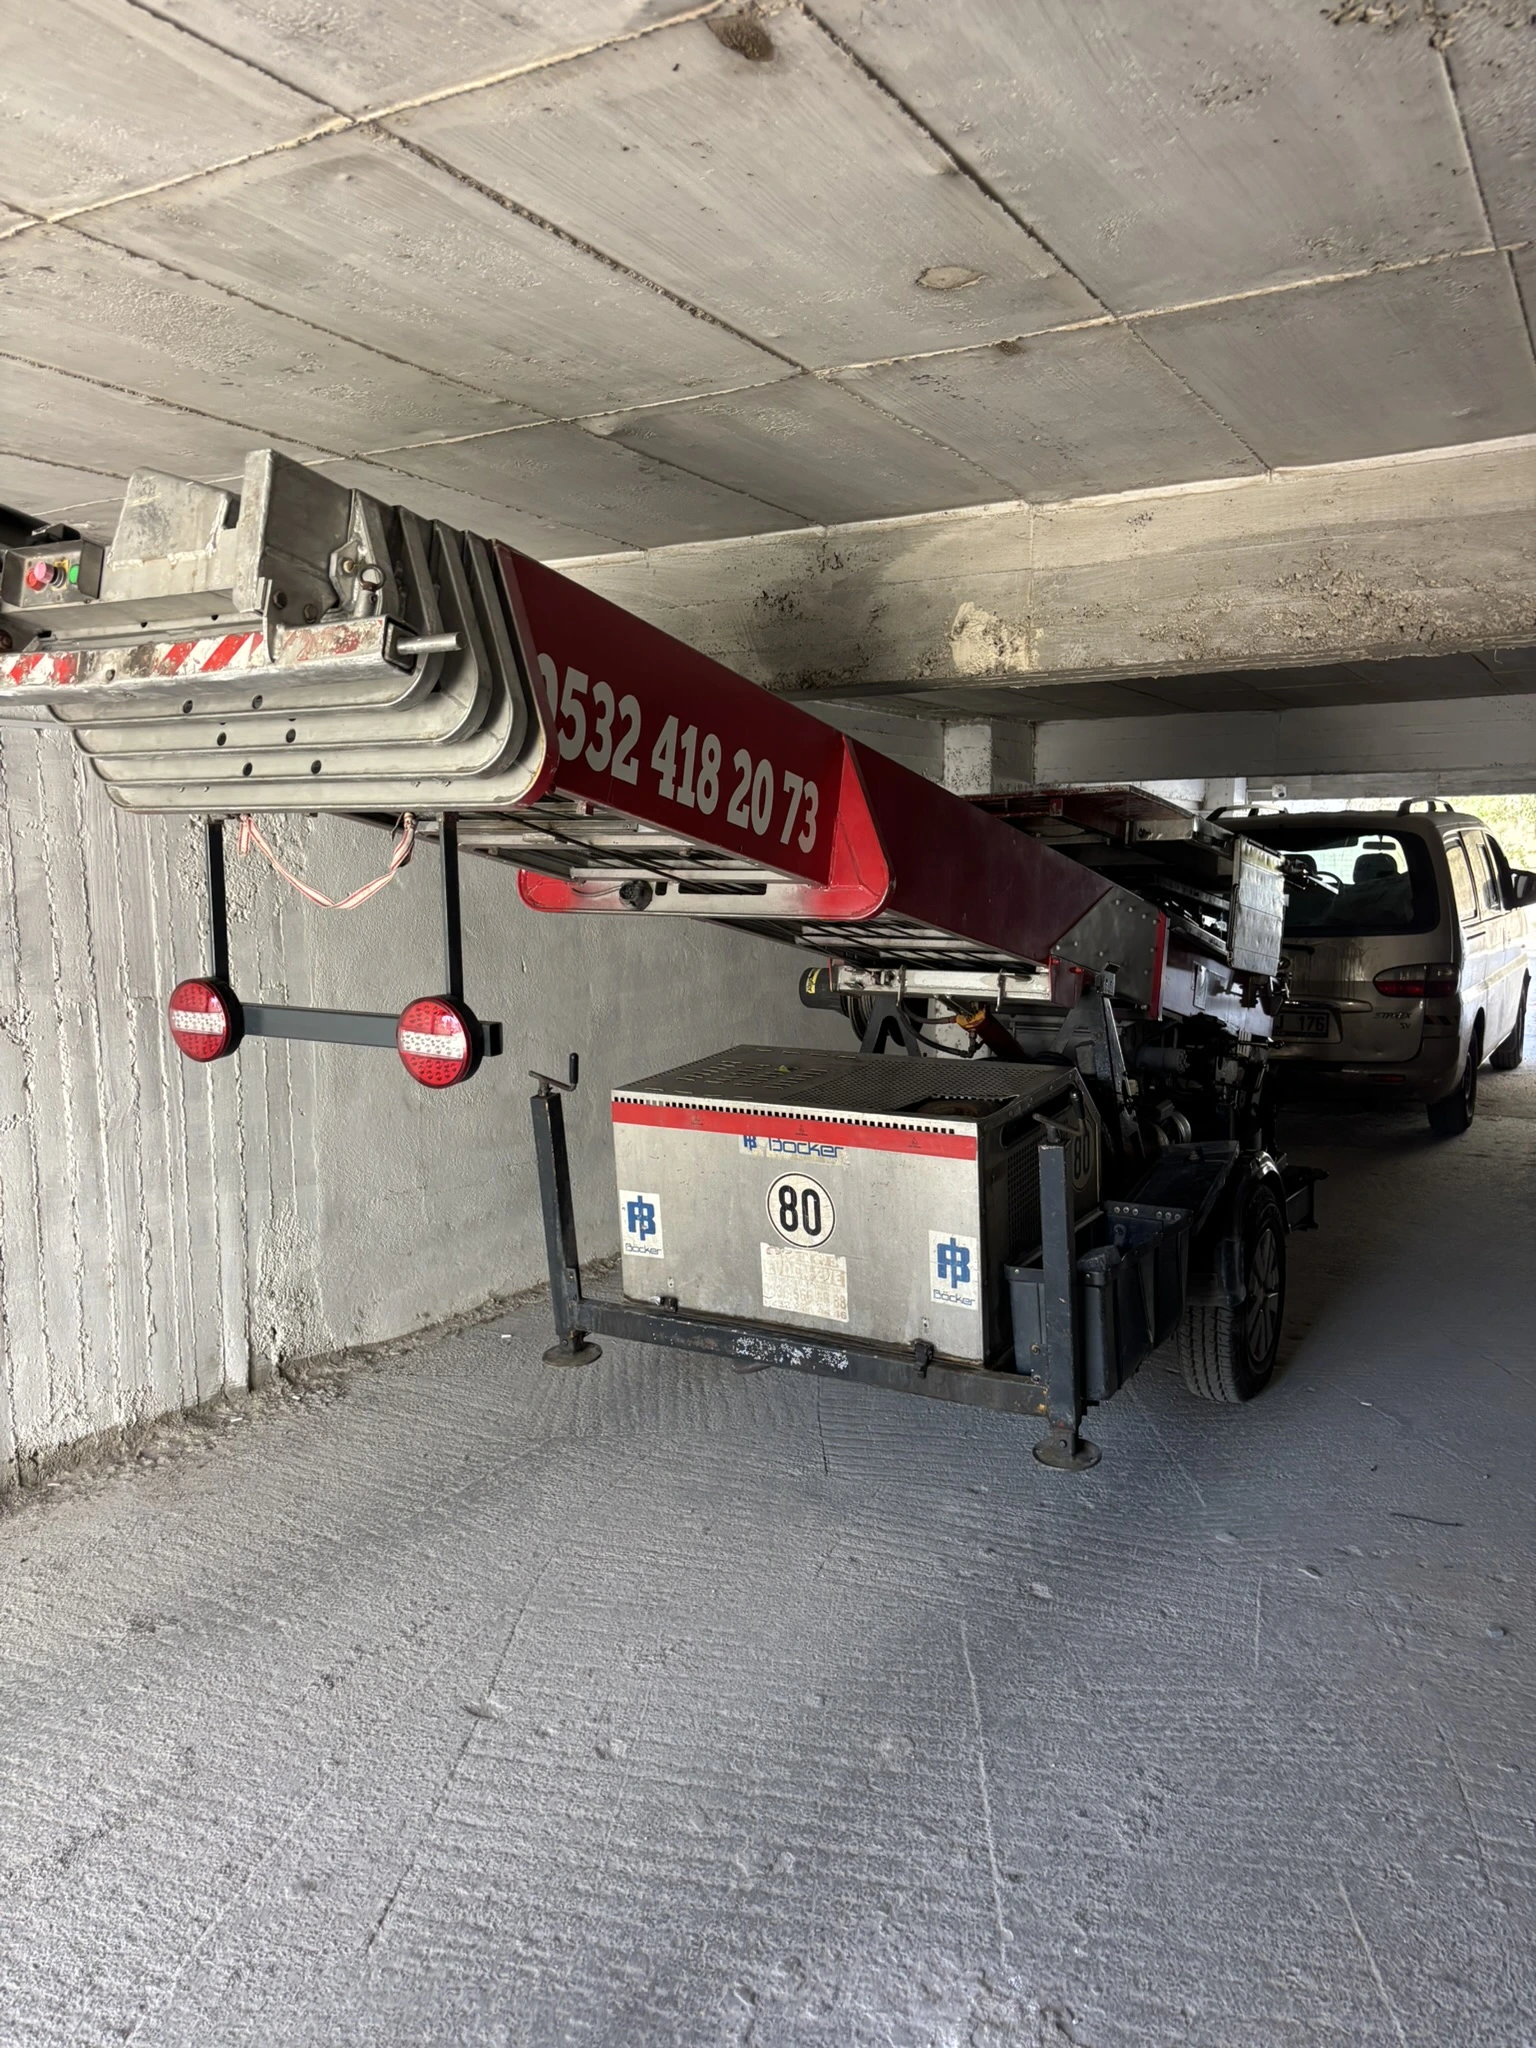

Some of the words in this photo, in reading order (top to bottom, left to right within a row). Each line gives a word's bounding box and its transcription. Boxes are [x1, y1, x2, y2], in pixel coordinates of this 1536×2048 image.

[651, 715, 721, 815] 418
[727, 748, 774, 835] 20
[780, 770, 818, 853] 73
[1299, 1015, 1325, 1031] 176
[778, 1185, 822, 1237] 80
